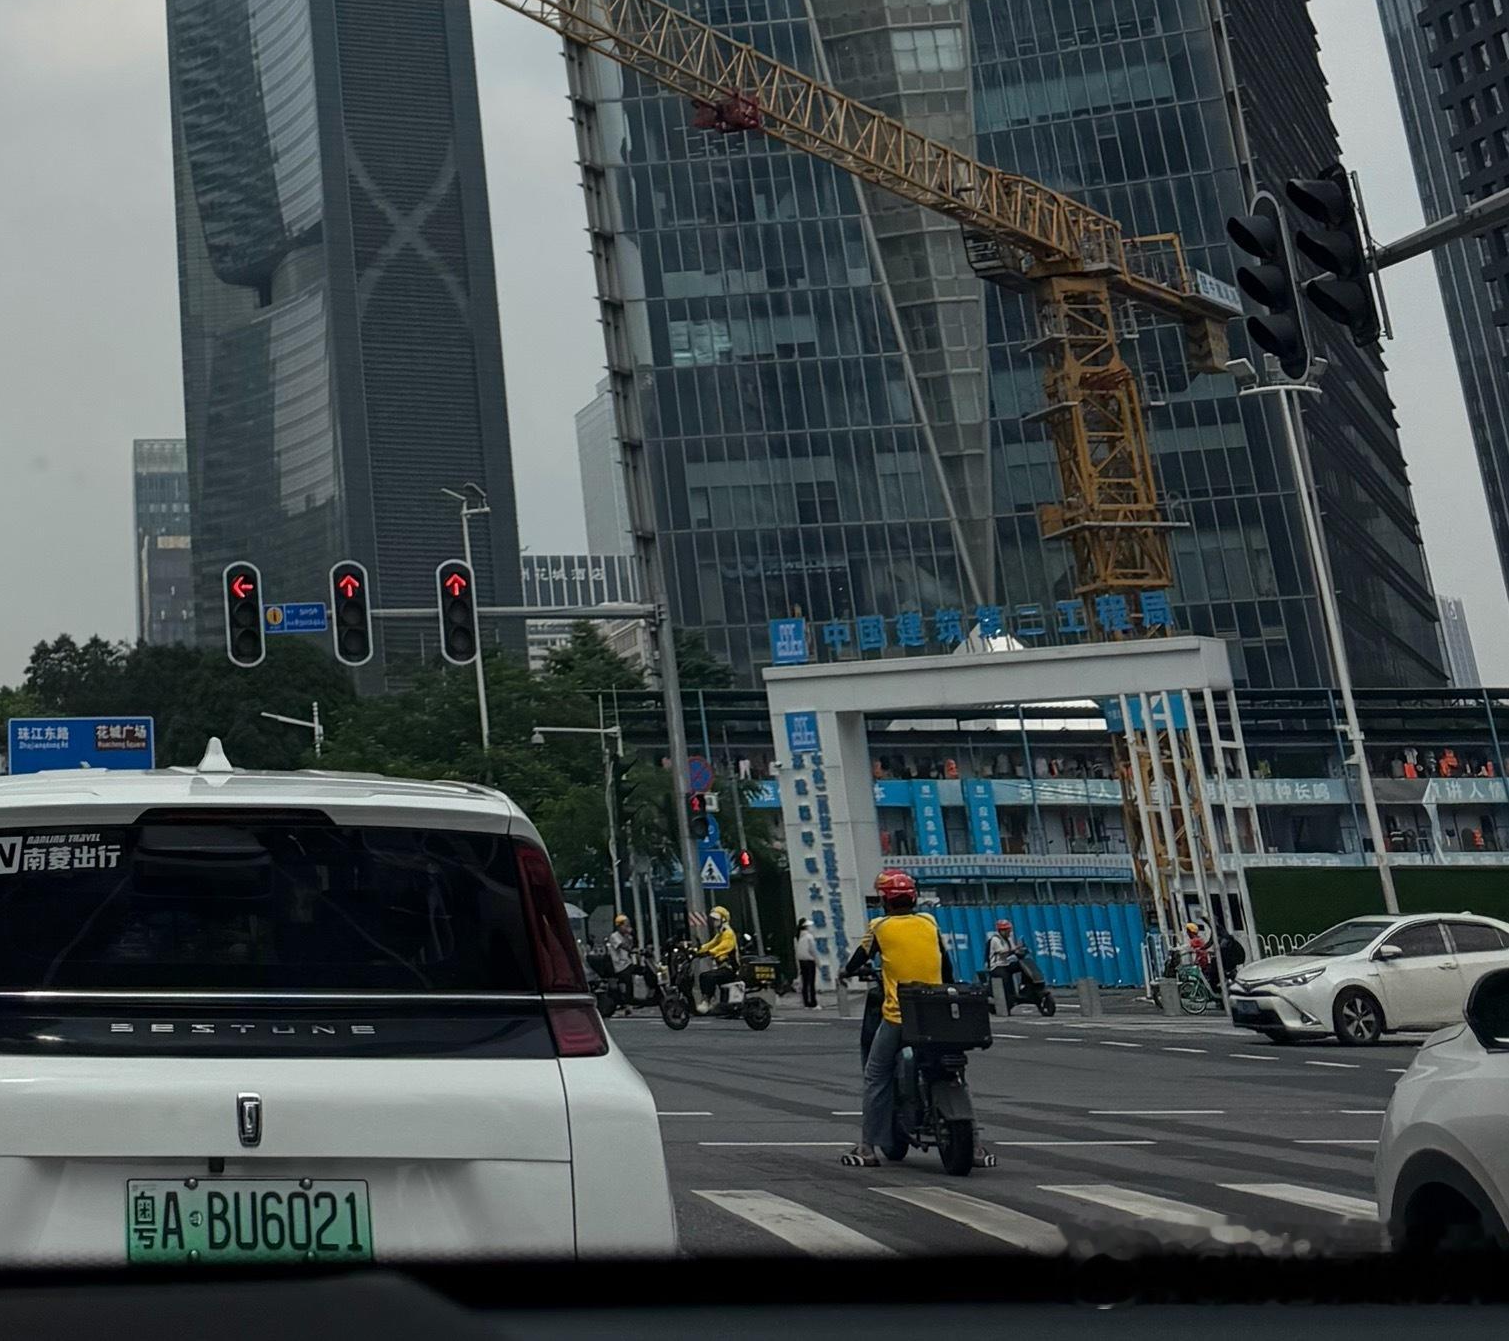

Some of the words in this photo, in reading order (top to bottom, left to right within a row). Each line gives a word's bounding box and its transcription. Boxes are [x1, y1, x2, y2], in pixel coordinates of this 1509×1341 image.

[18, 727, 69, 740] 珠江东路
[96, 725, 147, 739] 花城广场
[23, 845, 121, 871] 南菱出行
[110, 1023, 376, 1034] BESTUNE
